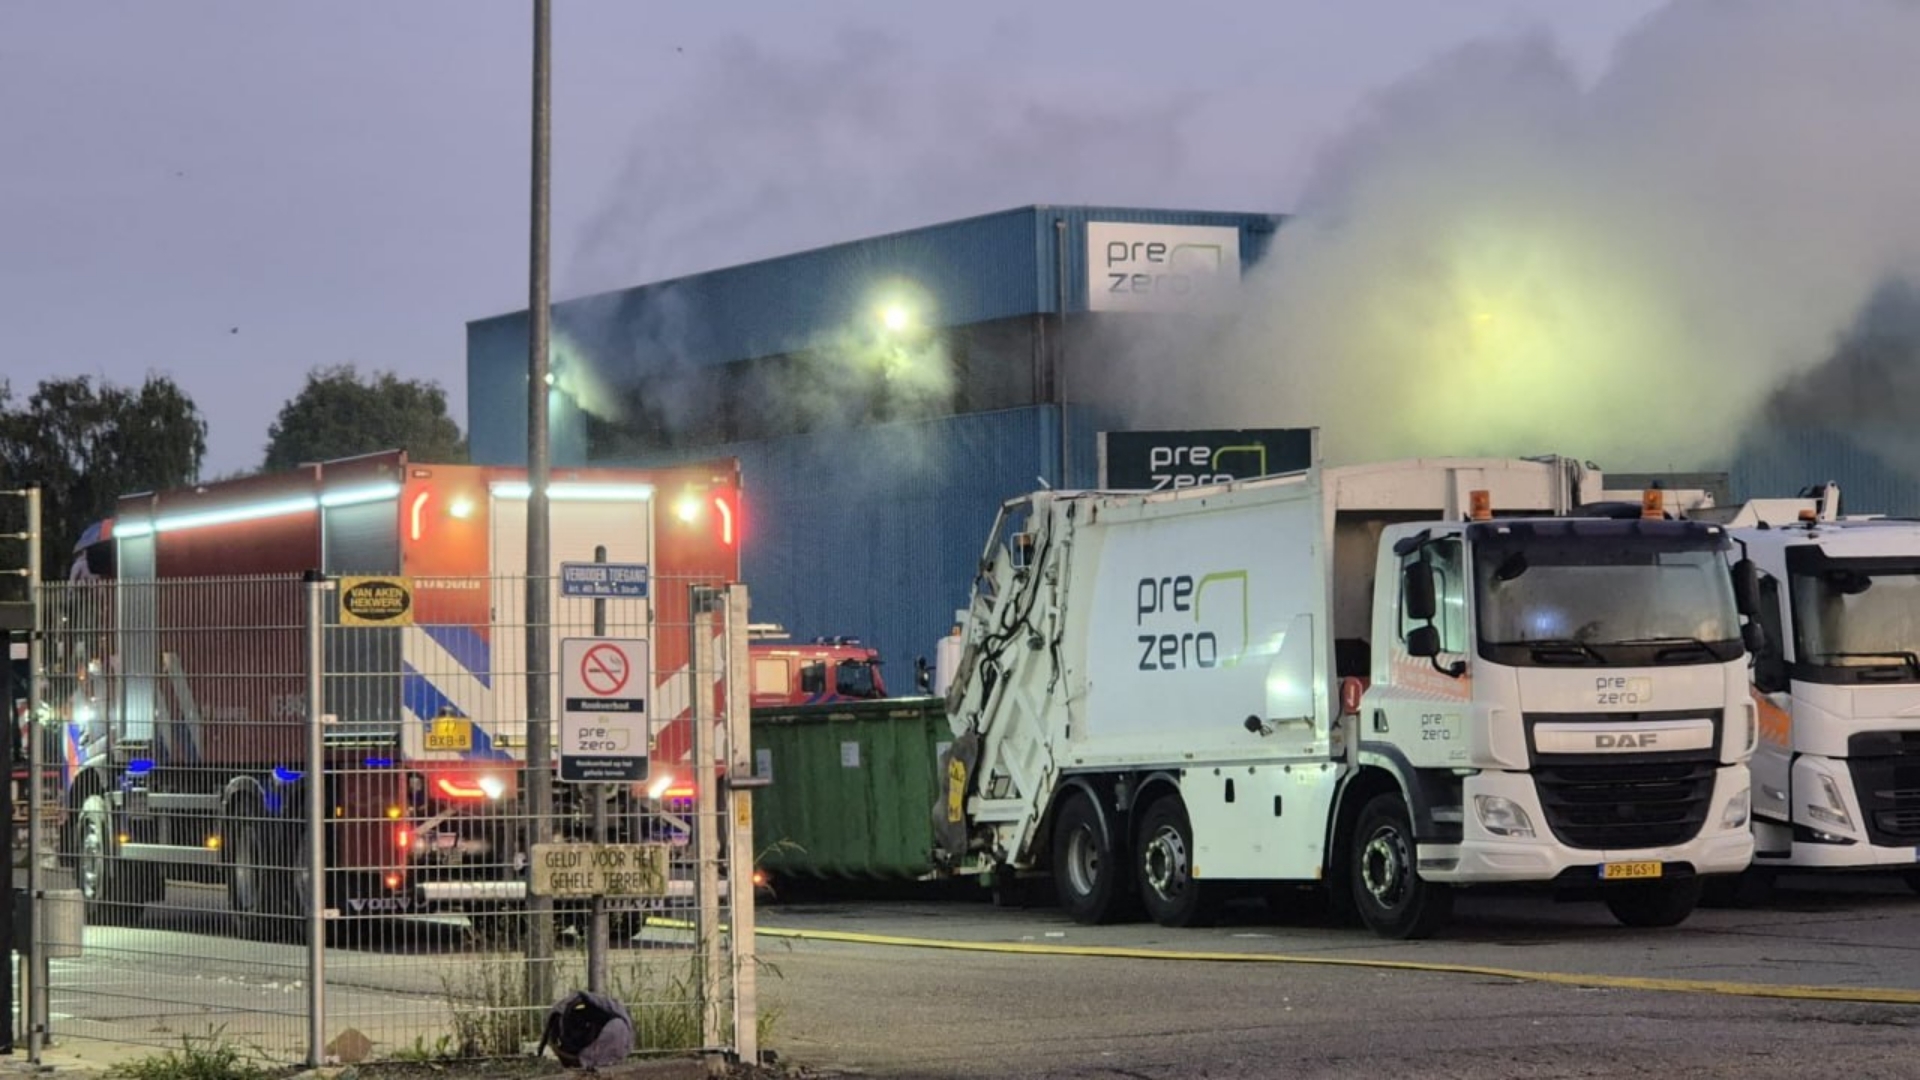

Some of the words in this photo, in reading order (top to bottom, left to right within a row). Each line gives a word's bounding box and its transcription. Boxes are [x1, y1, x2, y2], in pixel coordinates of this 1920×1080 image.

[1107, 241, 1167, 268] pre
[1108, 273, 1191, 295] zero
[1151, 446, 1212, 472] pre
[351, 587, 373, 598] VAN
[375, 587, 403, 598] AKEN
[1138, 574, 1193, 625] pre
[1138, 630, 1217, 670] zero
[1596, 677, 1626, 691] pre
[1597, 693, 1638, 704] zero
[1421, 713, 1442, 726] pre
[578, 727, 606, 739] pre
[1421, 729, 1451, 741] zero
[1595, 733, 1657, 748] DAF
[578, 741, 616, 751] zero
[545, 851, 582, 868] GELDT
[590, 850, 626, 868] VOOR
[550, 872, 594, 889] GEHELE
[603, 872, 652, 889] TERREIN
